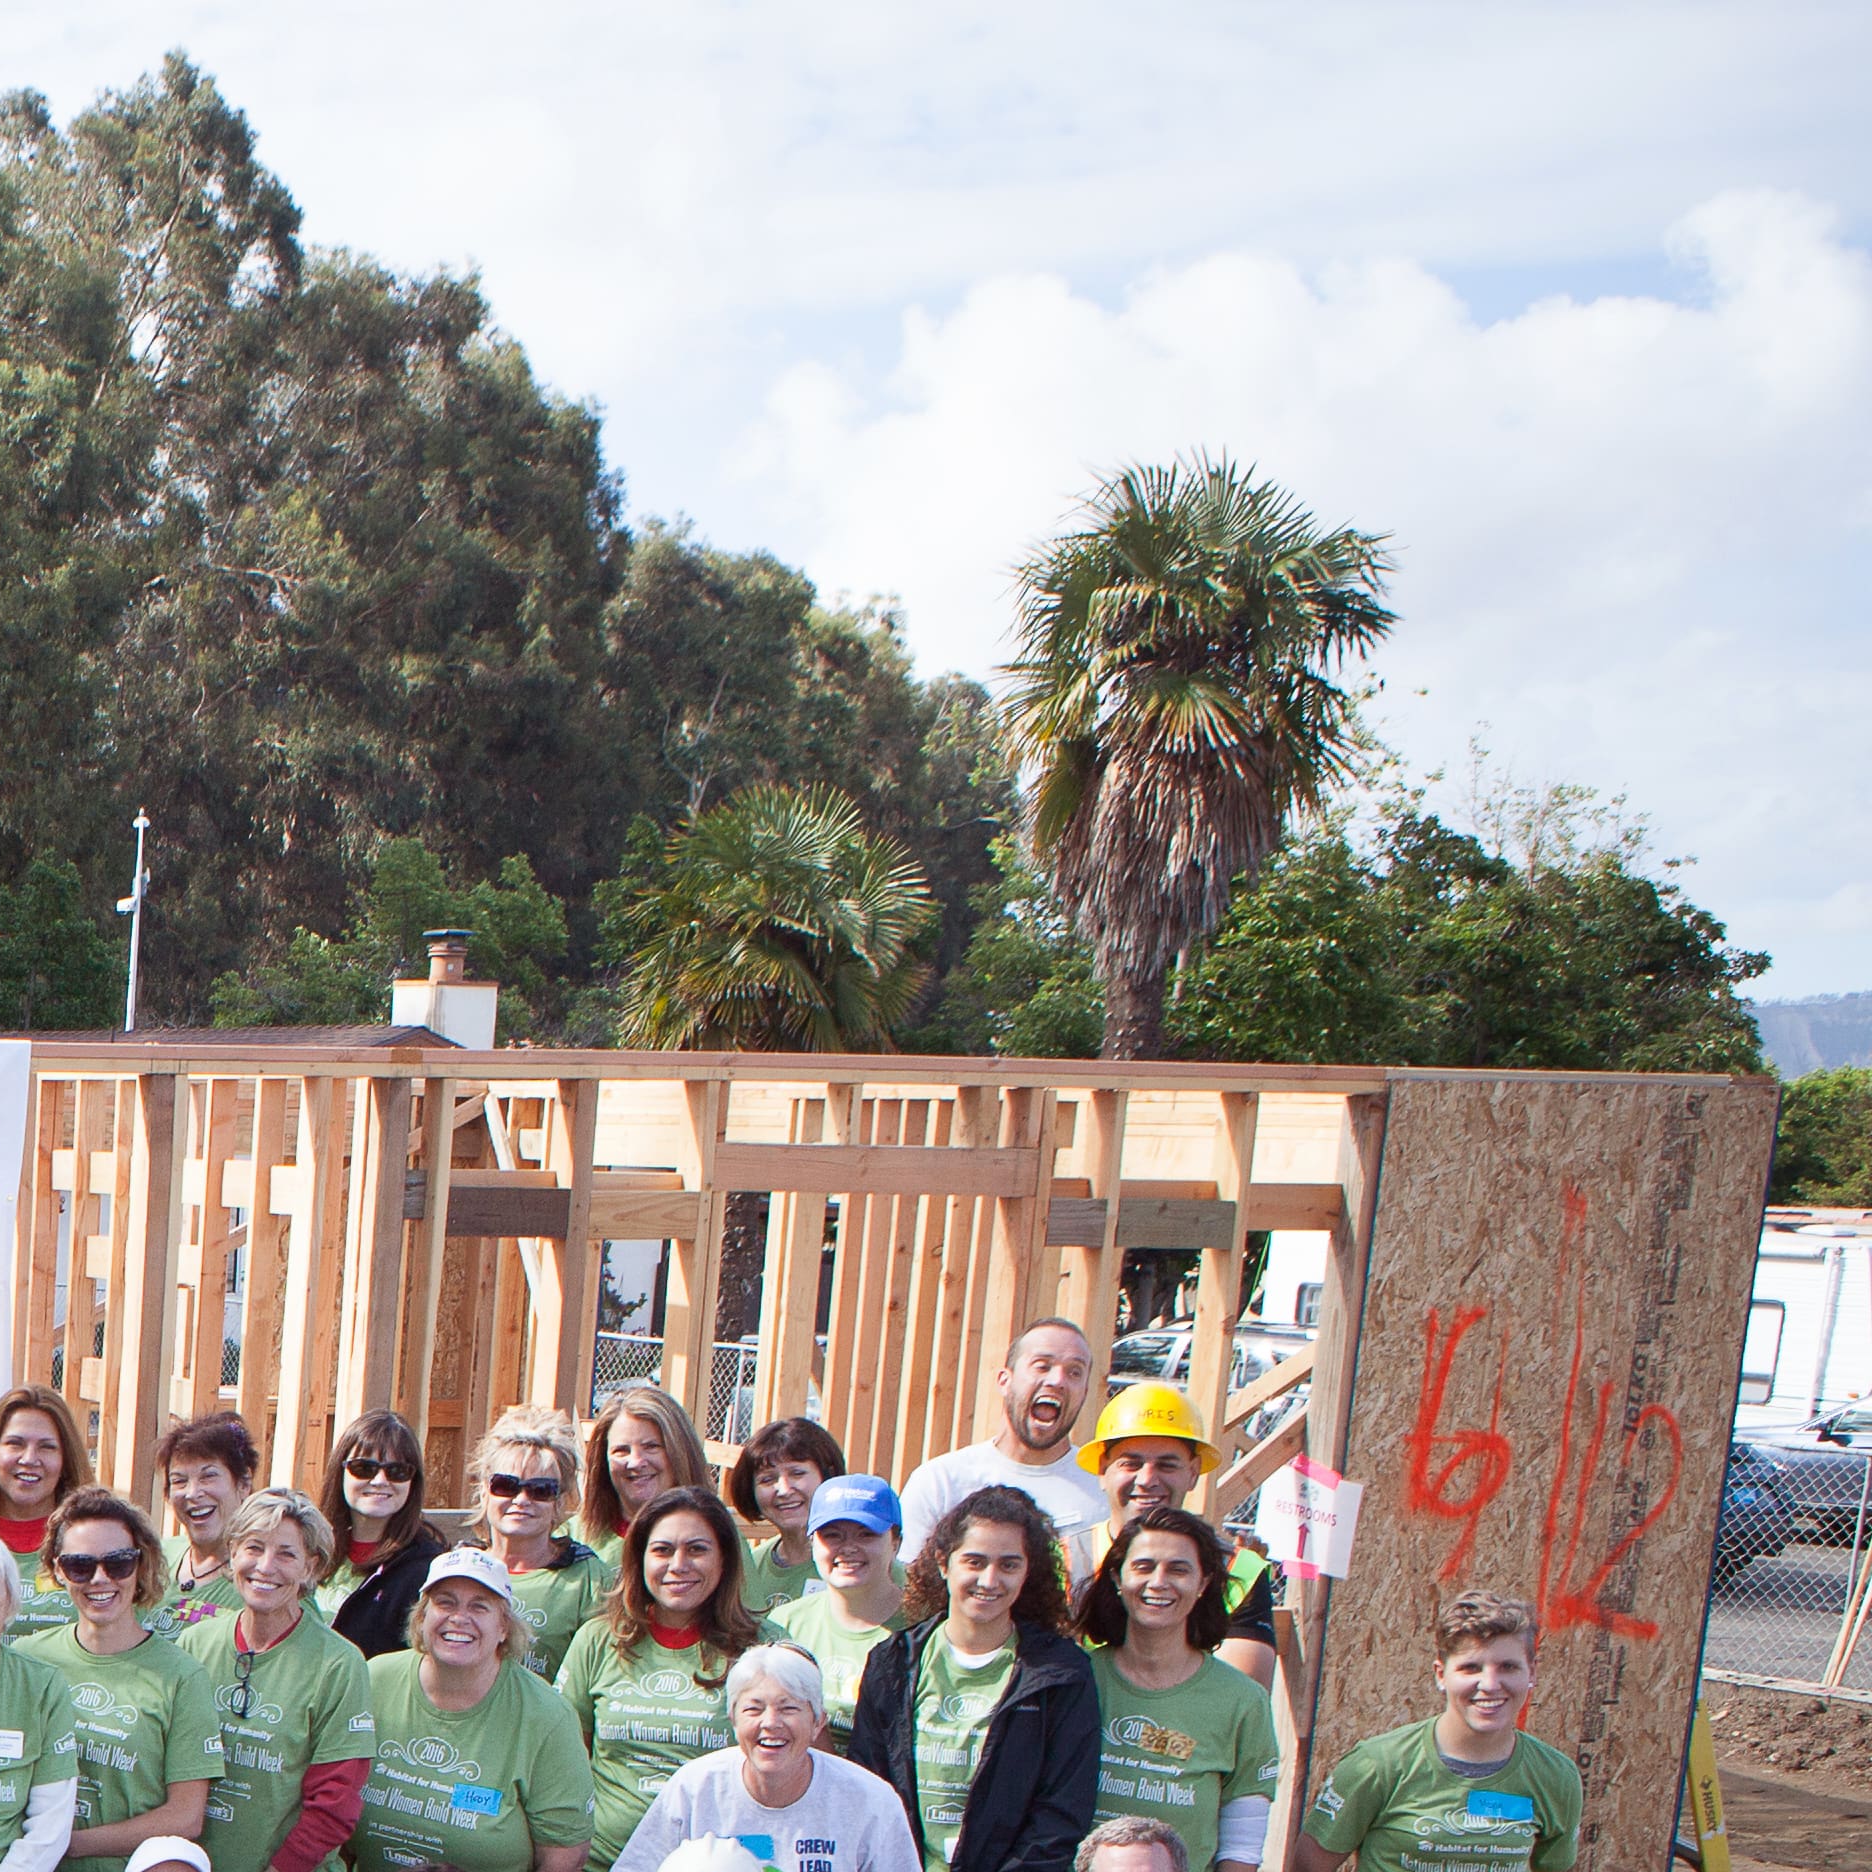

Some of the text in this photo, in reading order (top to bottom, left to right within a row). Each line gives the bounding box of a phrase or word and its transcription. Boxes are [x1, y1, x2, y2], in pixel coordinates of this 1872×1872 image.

[1275, 1500, 1337, 1527] RESTROOMS
[654, 1676, 680, 1693] 2016
[76, 1689, 102, 1709] 2016
[629, 1723, 730, 1749] Women Week
[86, 1745, 138, 1773] Build Week
[233, 1748, 283, 1774] Build Week
[419, 1743, 447, 1763] 2016
[1137, 1776, 1196, 1806] Build Week
[387, 1787, 480, 1830] Women Week
[795, 1839, 835, 1855] CREW
